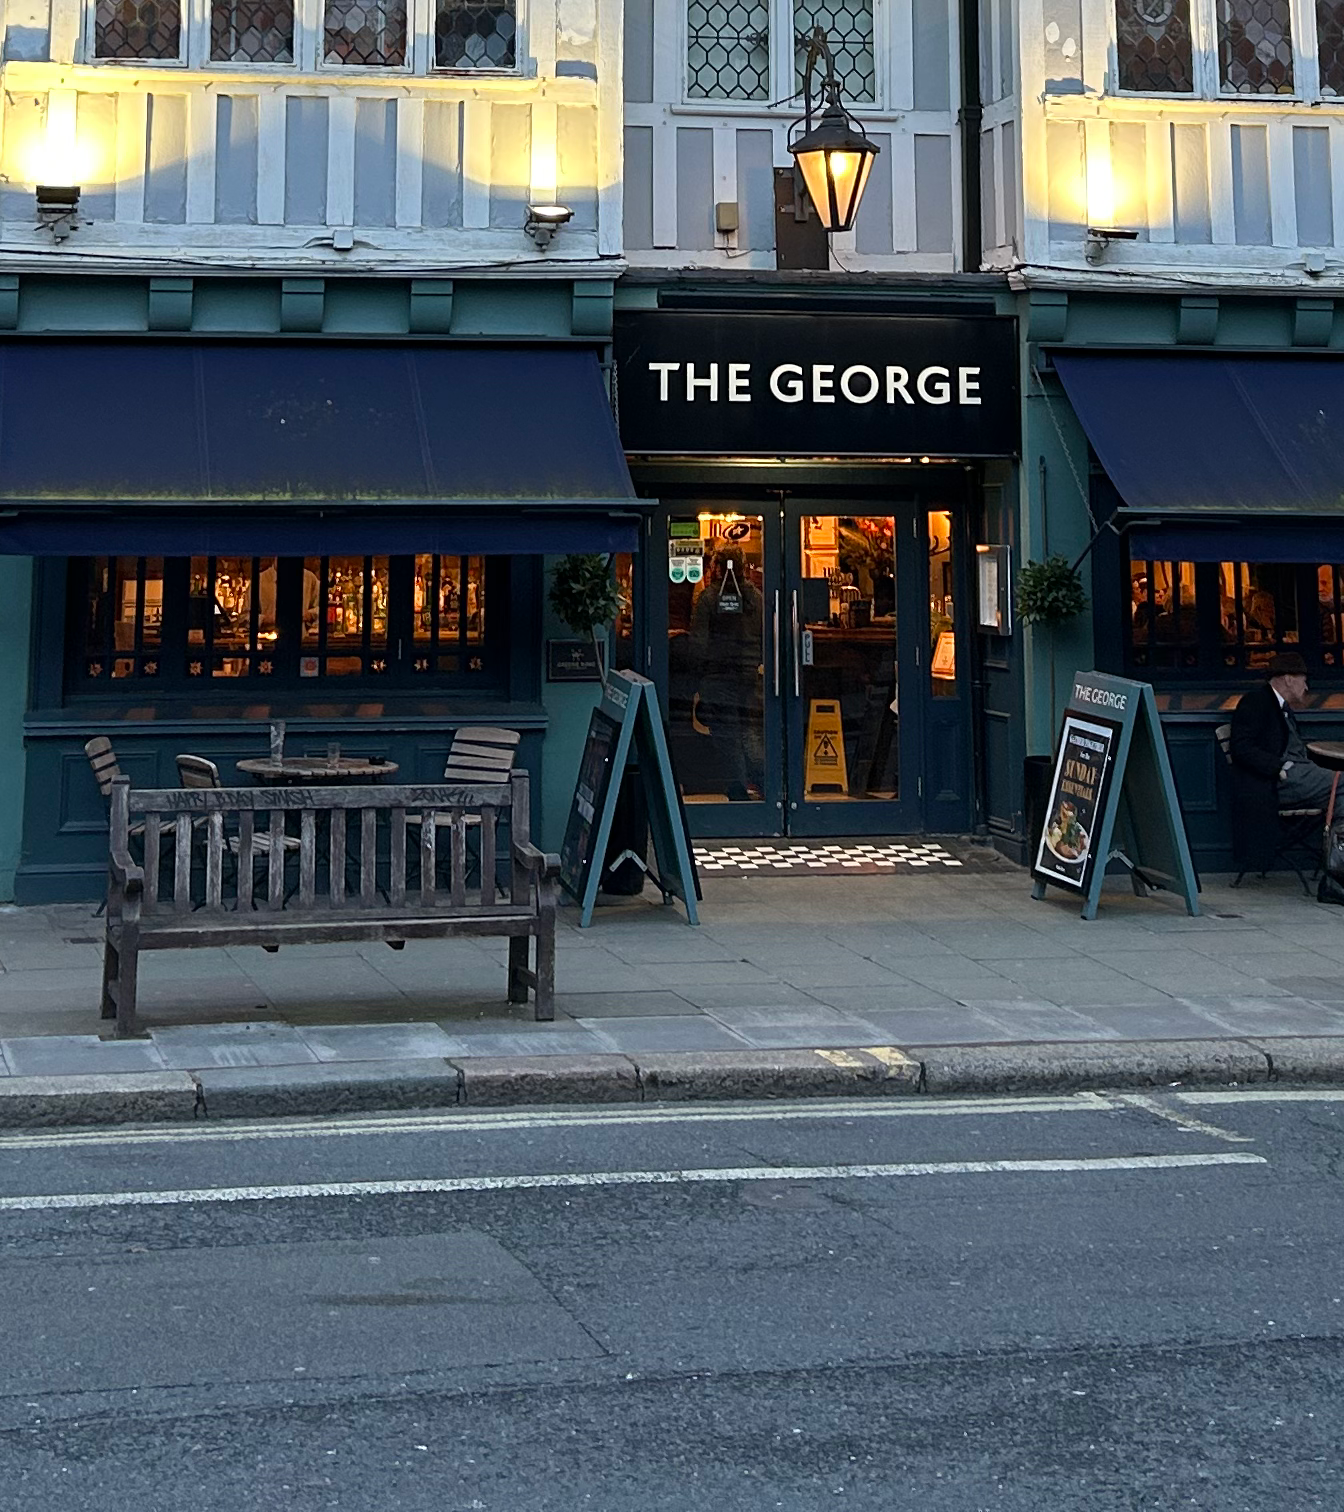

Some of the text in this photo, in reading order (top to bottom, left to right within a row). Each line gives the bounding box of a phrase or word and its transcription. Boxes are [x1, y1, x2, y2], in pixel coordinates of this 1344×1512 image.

[648, 362, 983, 406] THE GEORGE
[1075, 683, 1128, 710] THE GEORGE
